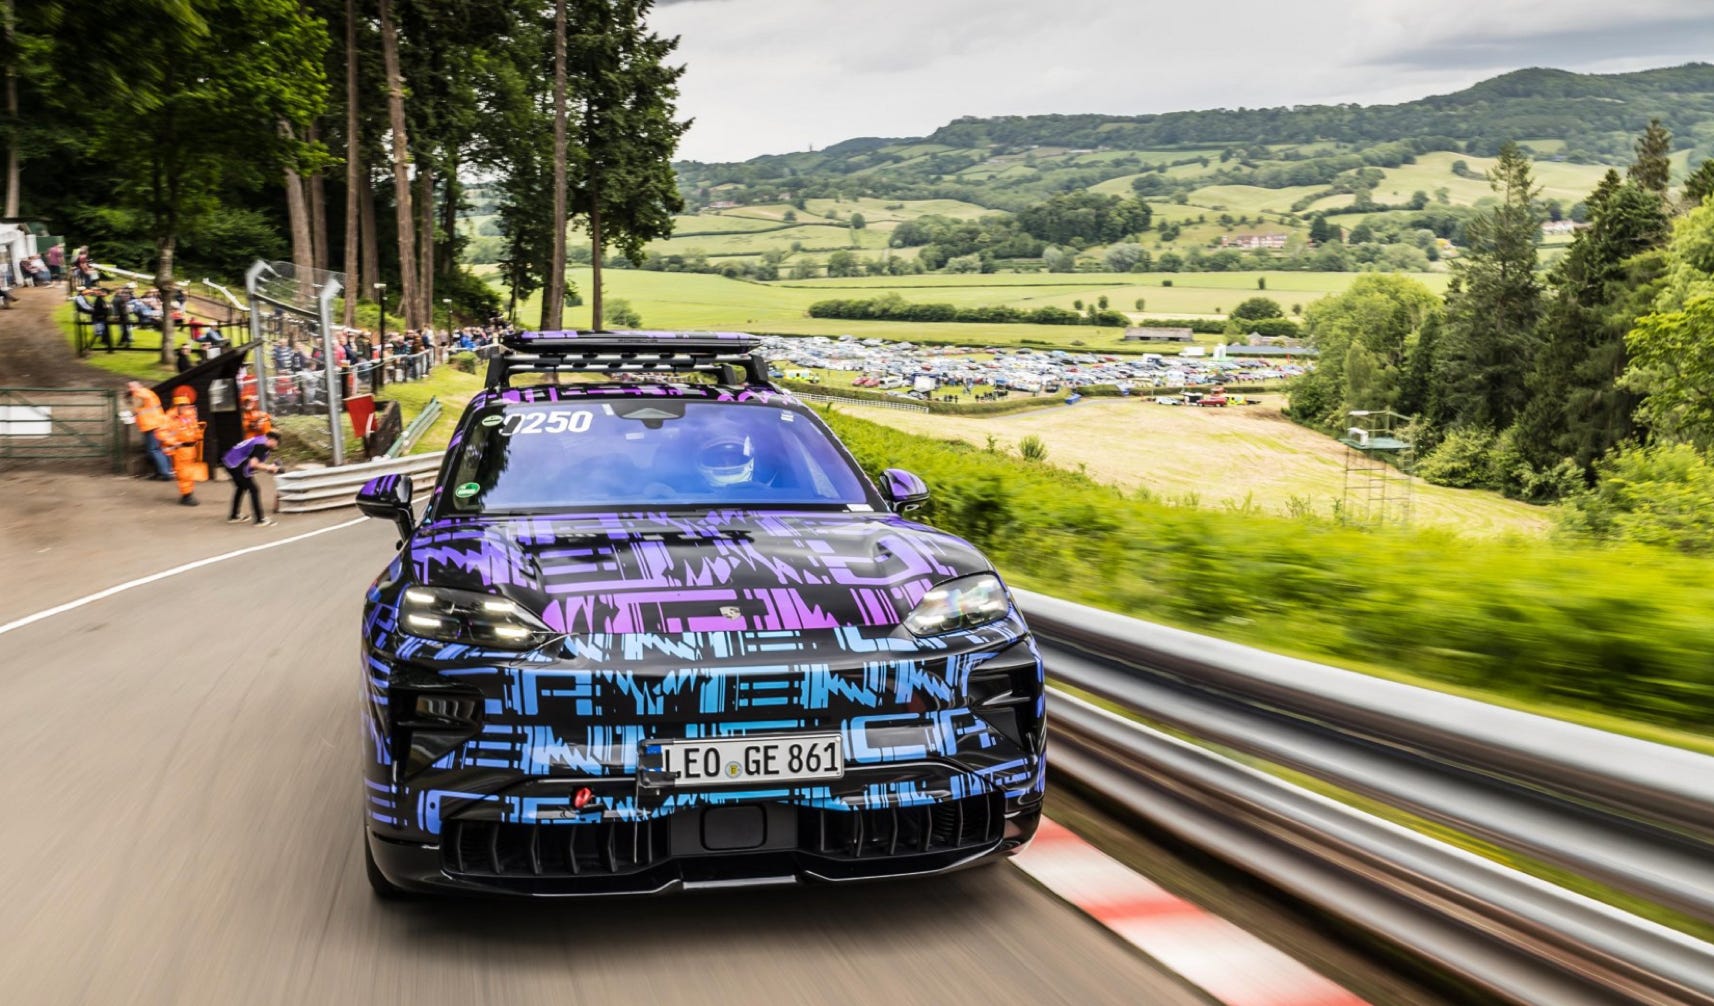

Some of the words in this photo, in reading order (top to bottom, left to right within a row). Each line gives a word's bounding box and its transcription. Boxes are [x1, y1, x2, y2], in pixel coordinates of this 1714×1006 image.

[665, 747, 721, 779] LEO
[744, 745, 780, 776] GE
[787, 742, 839, 774] 861
